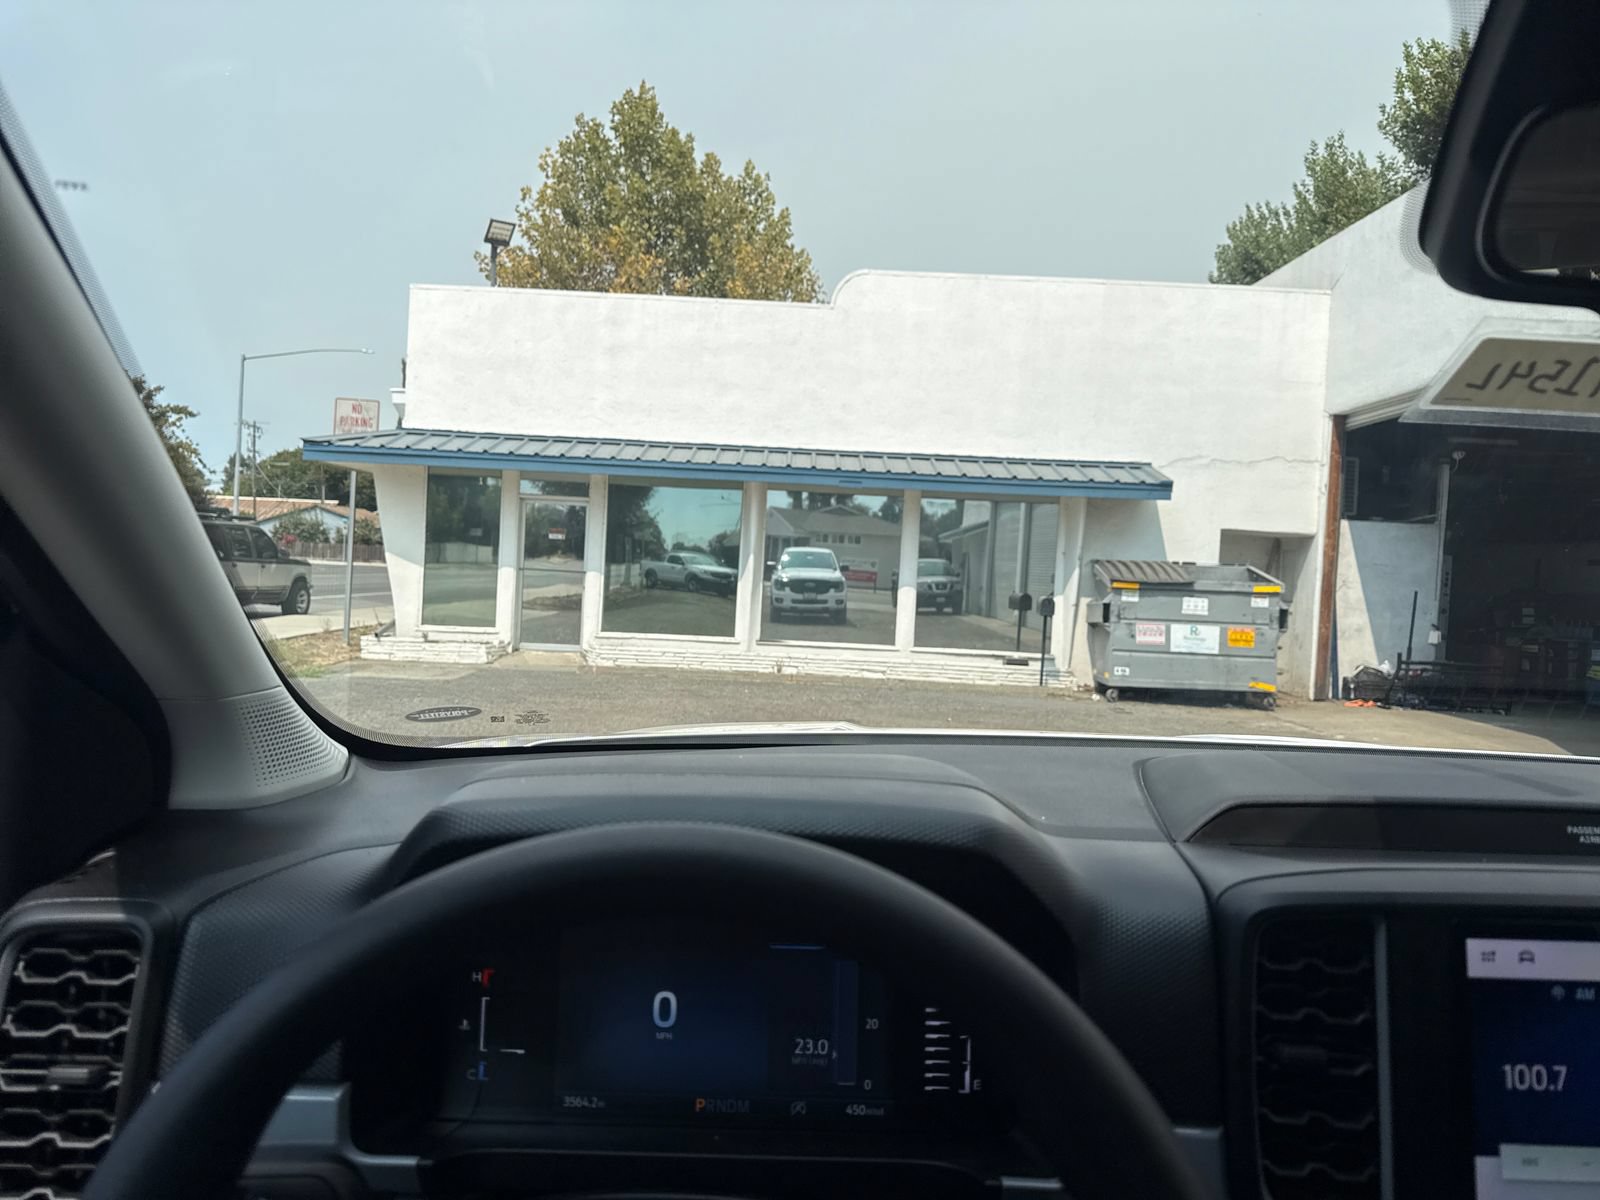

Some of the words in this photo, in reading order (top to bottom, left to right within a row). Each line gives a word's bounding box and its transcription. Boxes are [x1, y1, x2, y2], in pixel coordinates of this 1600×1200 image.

[351, 403, 363, 414] NO
[340, 416, 373, 428] PARKING
[471, 970, 482, 983] H
[1575, 987, 1596, 1001] AM
[652, 990, 679, 1029] 0
[864, 1017, 880, 1031] 20
[655, 1031, 673, 1041] MPH
[793, 1037, 829, 1056] 23.0
[973, 1078, 983, 1091] E
[1502, 1063, 1568, 1093] 100.7
[863, 1079, 873, 1092] 0
